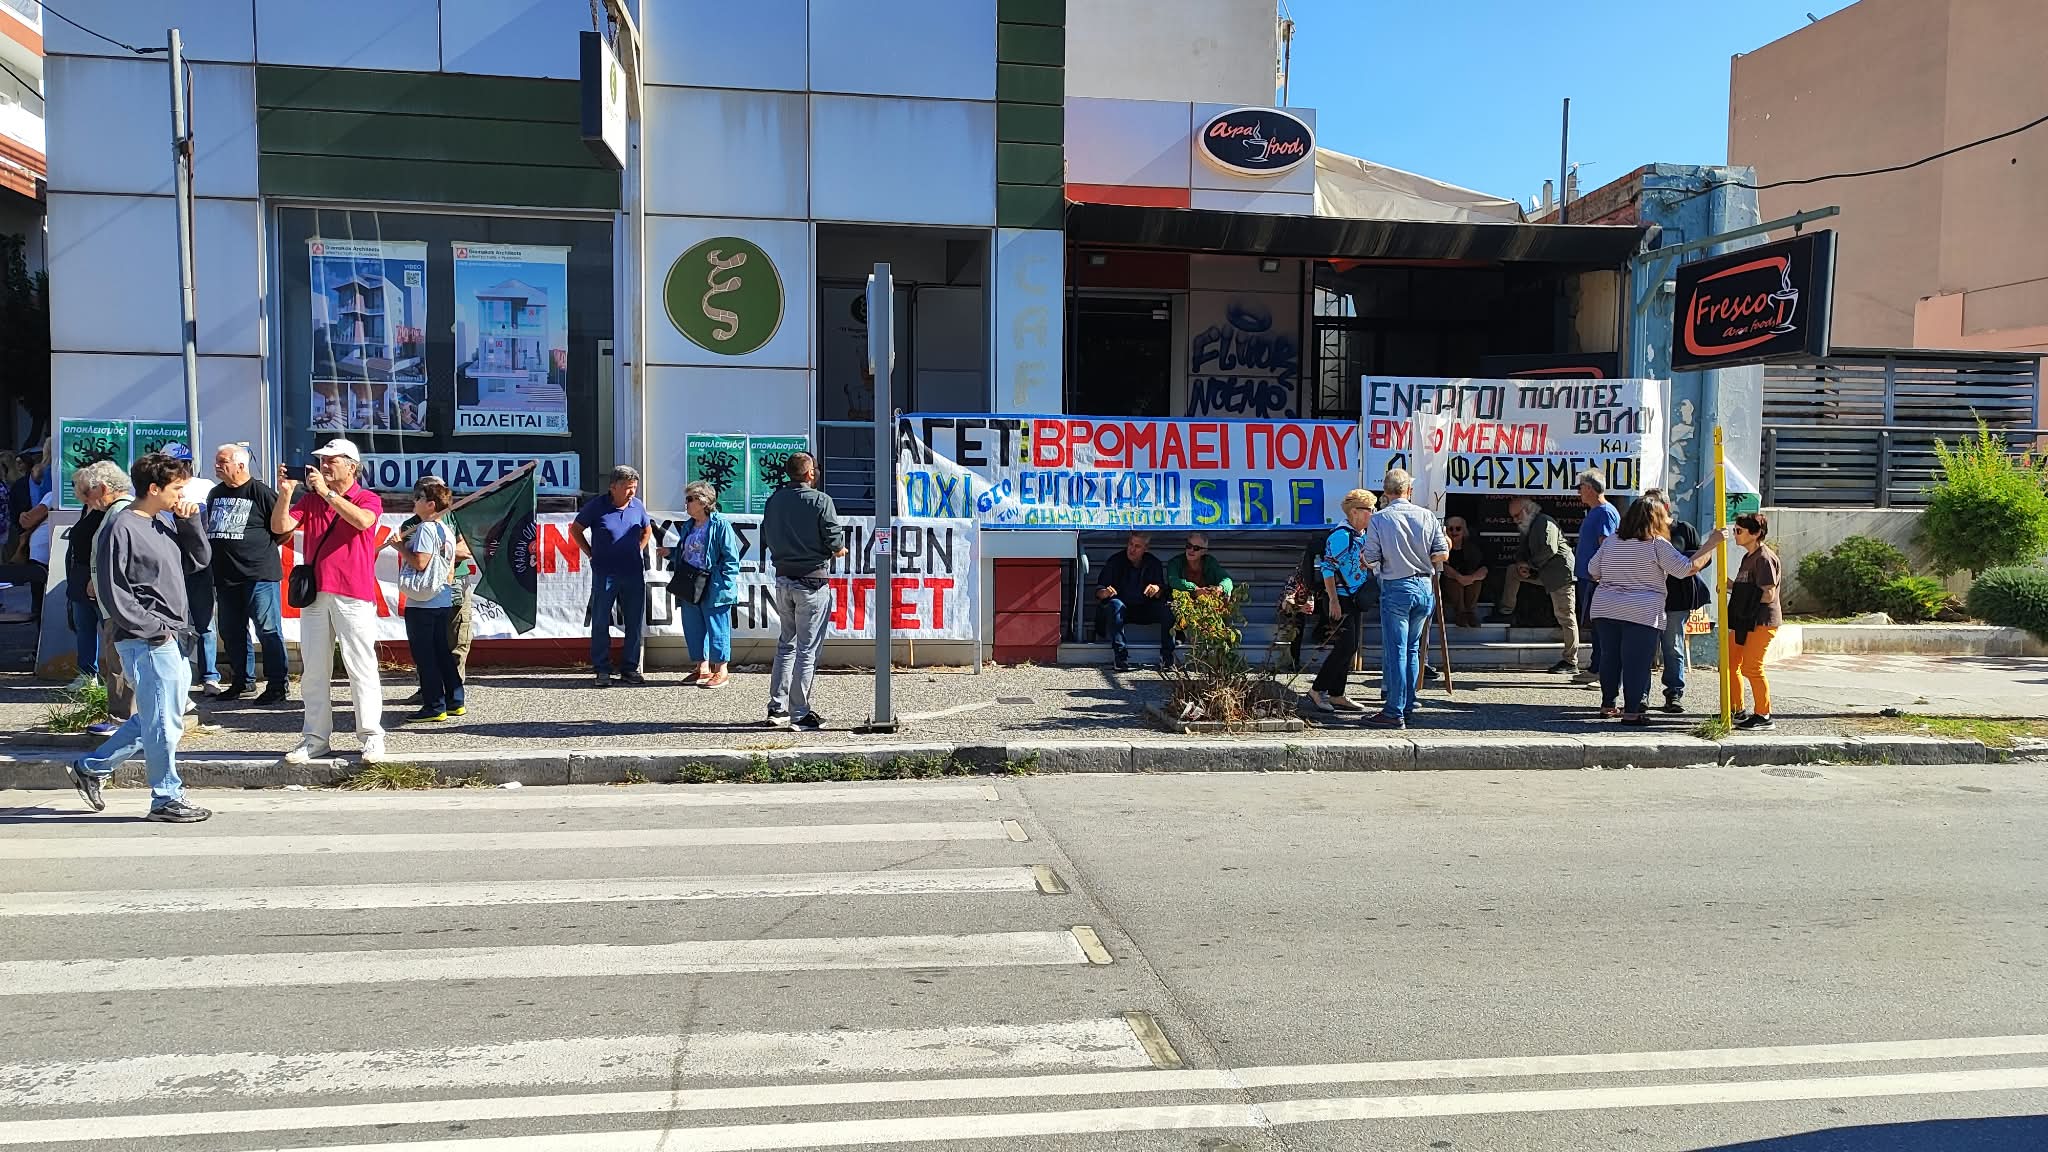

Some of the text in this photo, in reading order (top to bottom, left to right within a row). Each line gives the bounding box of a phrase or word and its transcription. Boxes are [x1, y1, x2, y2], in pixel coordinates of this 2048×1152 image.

[1264, 136, 1304, 159] foods
[1696, 293, 1767, 326] Fresco
[1518, 384, 1623, 409] ΠΟΛΙΤΕΣ
[460, 413, 542, 428] ΠΩΛΕΙΤΑΙ
[1573, 407, 1655, 435] ΒΟΛΟΥ
[63, 425, 127, 437] αποκλεισμός!
[689, 439, 745, 450] αποκλεισμός!
[751, 441, 806, 451] αποκλεισμός!
[1033, 419, 1230, 469] ΒΡΩΜΑΕΙ
[1245, 423, 1356, 470] ΠΟΛΥ
[1686, 622, 1711, 633] STOP
